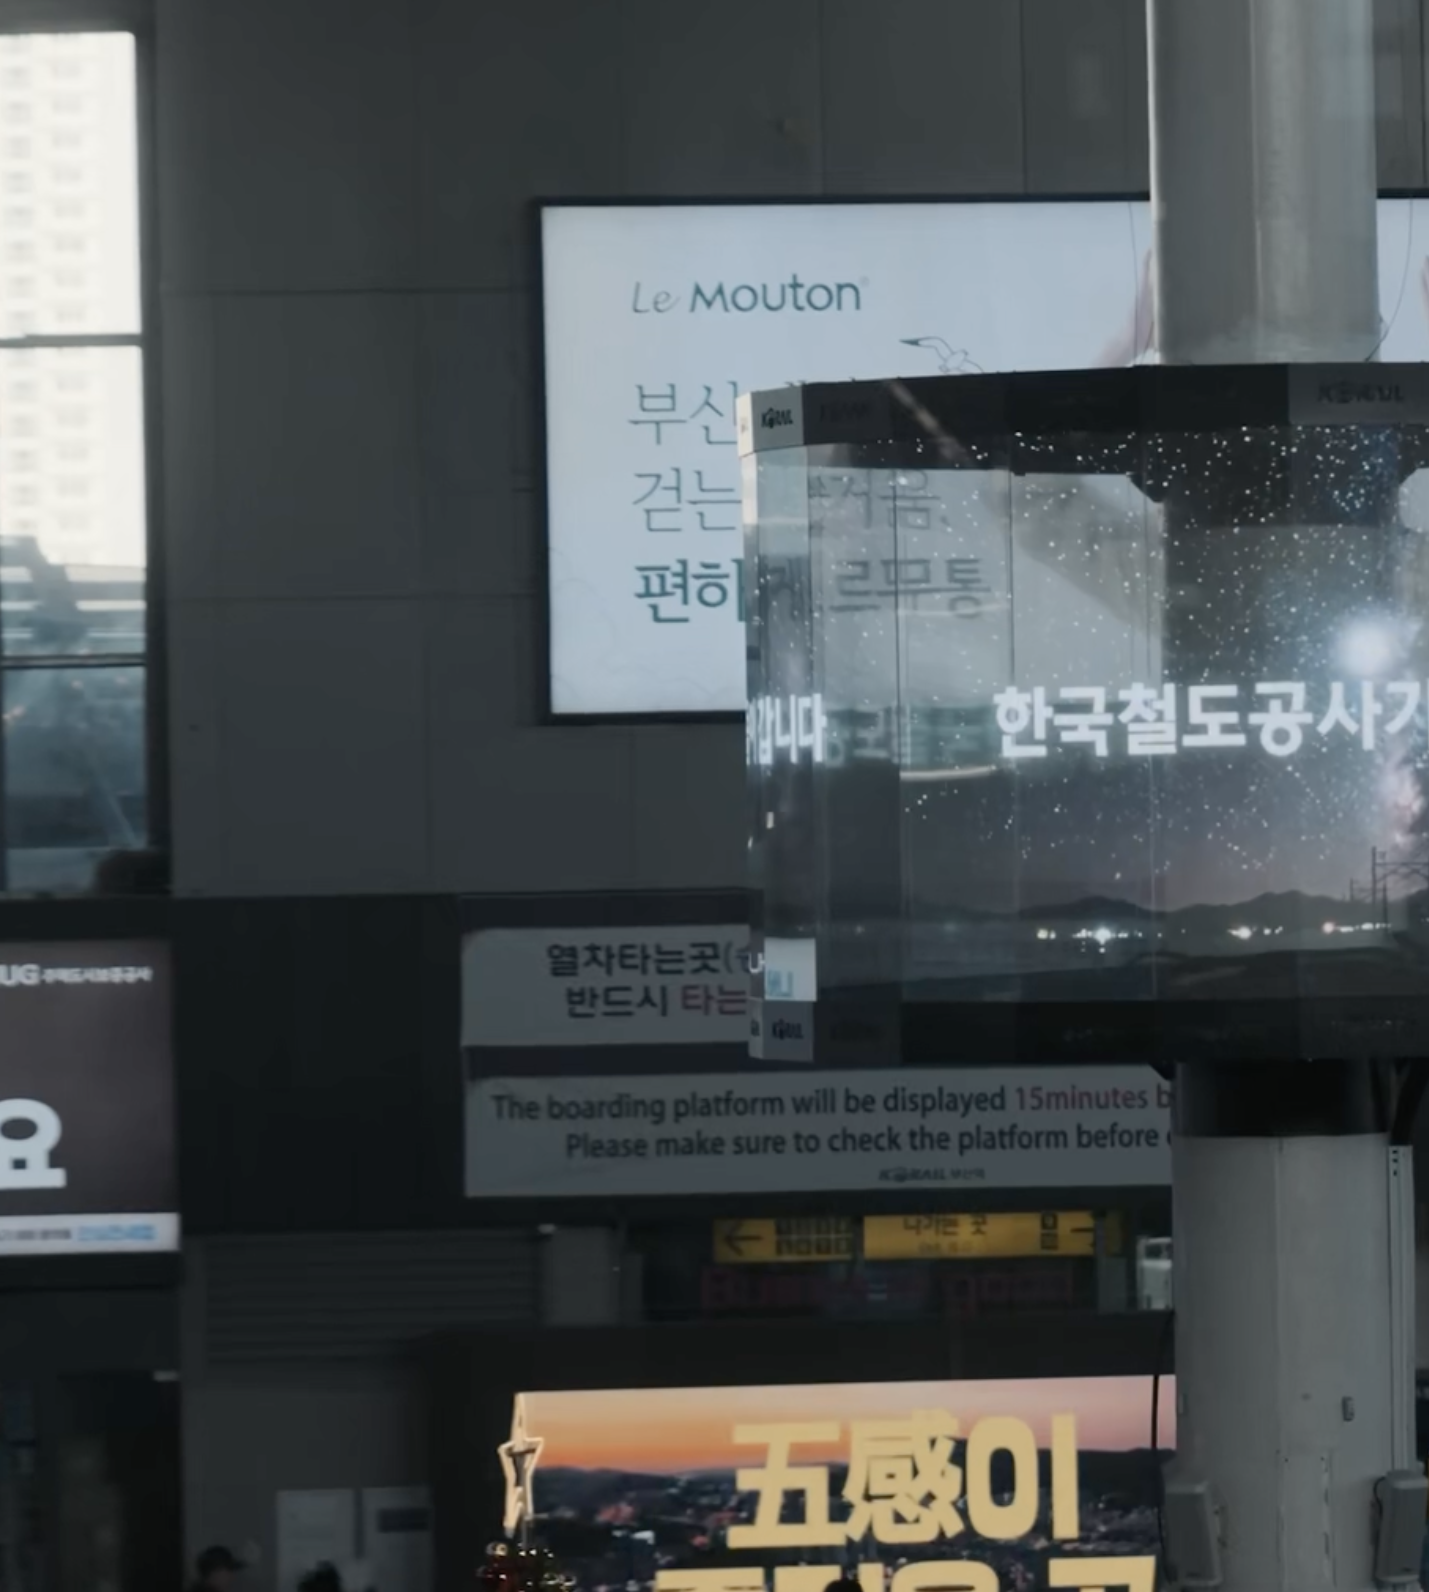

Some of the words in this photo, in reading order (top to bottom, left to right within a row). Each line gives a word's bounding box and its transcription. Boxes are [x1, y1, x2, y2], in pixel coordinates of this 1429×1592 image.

[631, 281, 678, 314] Le
[689, 274, 861, 313] Mouton
[627, 380, 738, 446] 부산
[632, 466, 742, 532] 걷는
[565, 984, 669, 1018] 반드시
[489, 1093, 541, 1121] The
[546, 1091, 666, 1126] boarding
[673, 1090, 785, 1124] platform
[791, 1087, 836, 1115] will
[844, 1087, 876, 1114] be
[882, 1085, 1006, 1119] displayed
[1015, 1084, 1149, 1111] 15minutes
[565, 1131, 649, 1159] Please
[655, 1129, 726, 1156] make
[732, 1133, 787, 1156] sure
[794, 1130, 821, 1154] to
[826, 1125, 903, 1153] check
[908, 1124, 953, 1151] the
[957, 1122, 1068, 1157] platform
[1076, 1121, 1160, 1149] before
[727, 1410, 1081, 1549] 五感이
